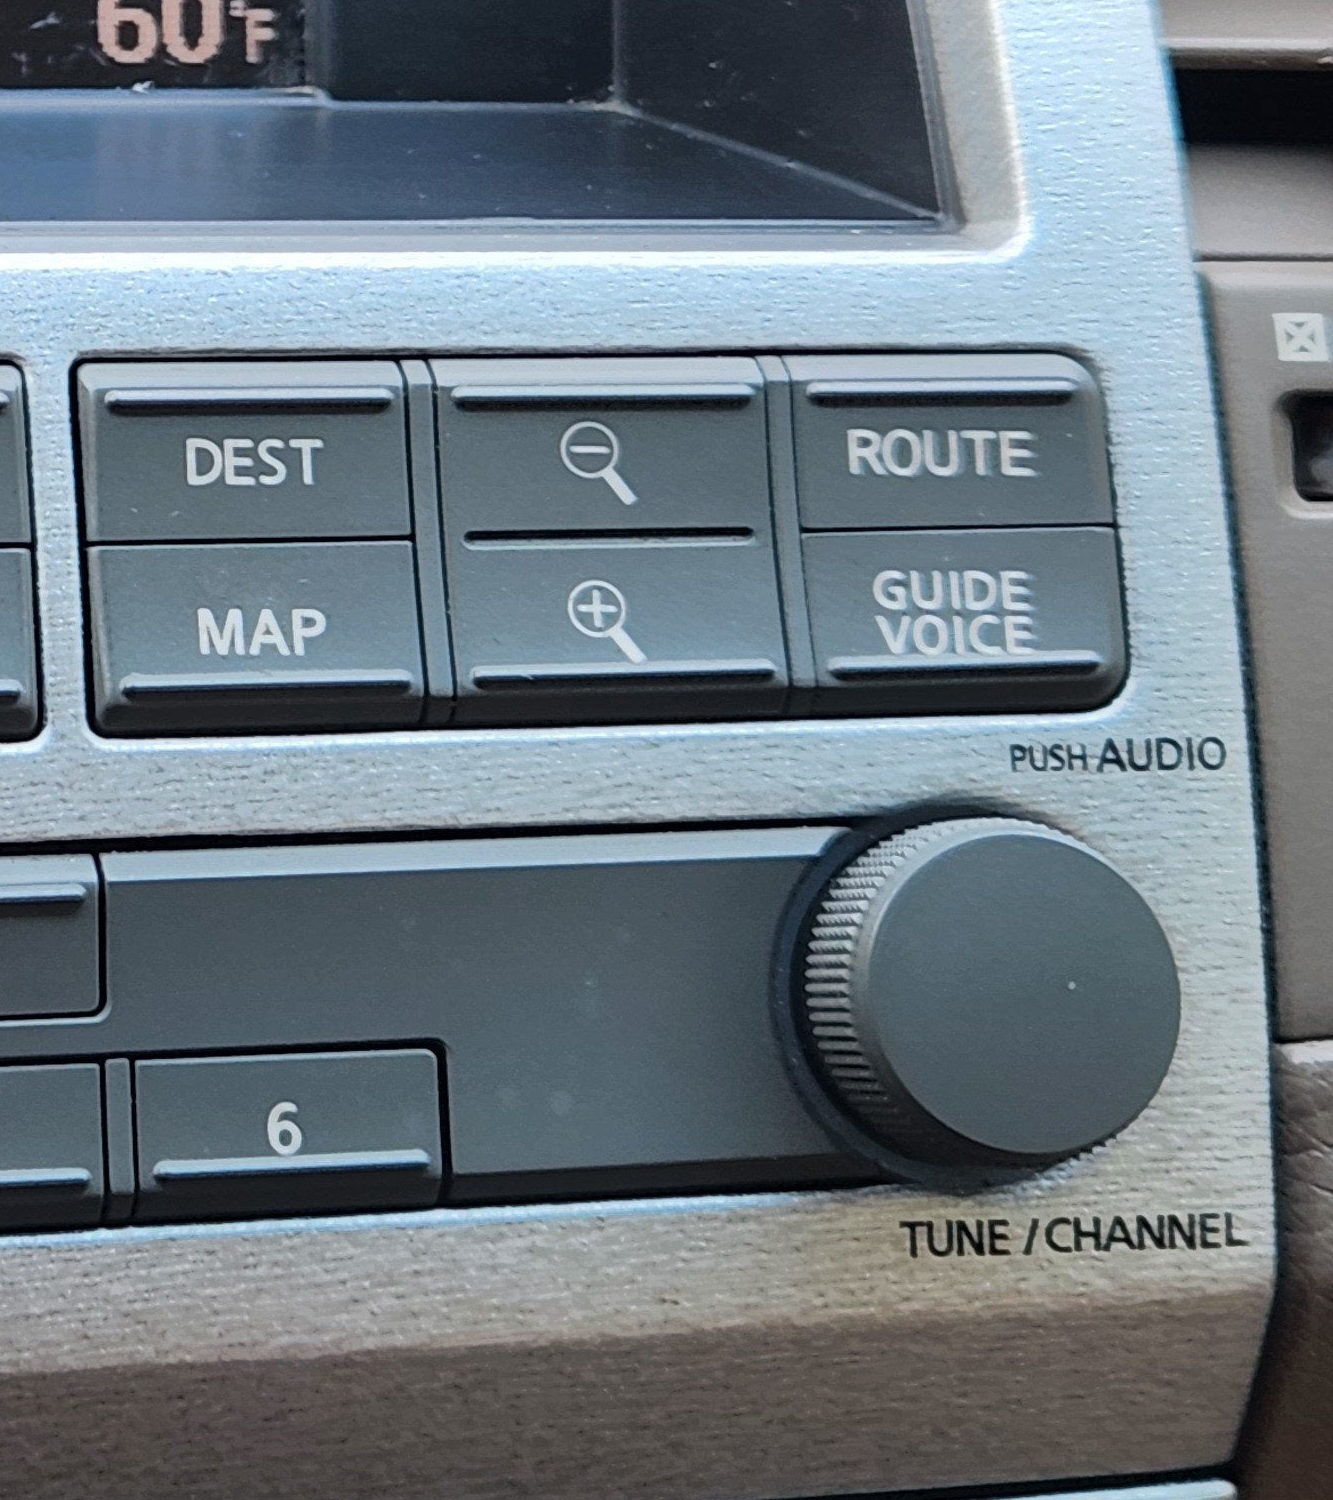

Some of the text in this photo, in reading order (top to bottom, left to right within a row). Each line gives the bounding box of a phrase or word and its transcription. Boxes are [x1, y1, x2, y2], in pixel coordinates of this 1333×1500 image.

[185, 436, 325, 487] DEST
[846, 429, 1037, 479] ROUTE
[872, 570, 1030, 614] GUIDE
[196, 607, 327, 658] MAP
[876, 612, 1036, 656] VOICE
[1008, 736, 1228, 773] PUSH AUDIO
[265, 1100, 304, 1157] 6
[900, 1220, 1012, 1258] TUNE
